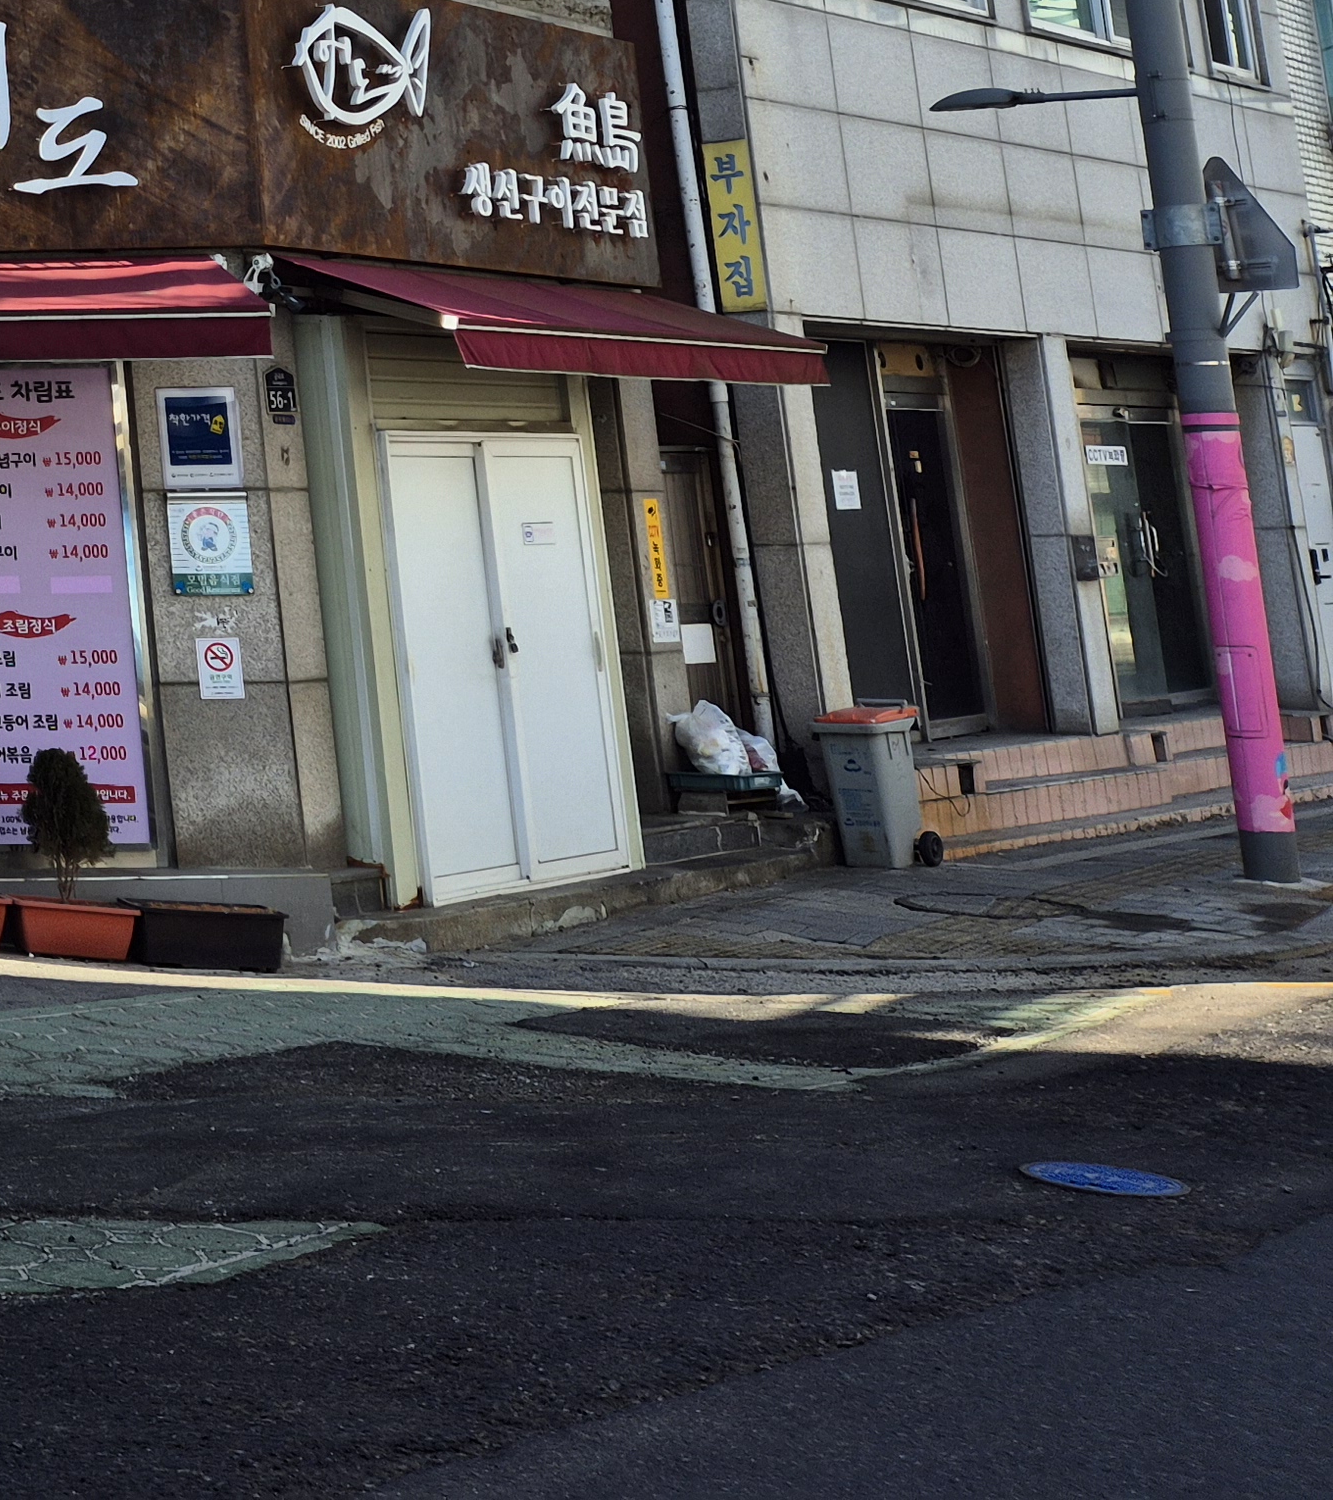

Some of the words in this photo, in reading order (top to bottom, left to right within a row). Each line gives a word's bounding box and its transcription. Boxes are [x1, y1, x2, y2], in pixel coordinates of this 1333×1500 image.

[299, 113, 326, 146] SINCE
[325, 131, 347, 149] 2002
[346, 124, 371, 150] Grilled
[368, 117, 386, 139] Fish
[461, 162, 649, 238] 생선구이전문점
[710, 153, 754, 299] 부자집
[10, 380, 76, 403] 차림표
[269, 391, 296, 411] 56-1
[3, 619, 57, 634] 조림정식
[5, 682, 31, 700] 조림
[33, 714, 59, 731] 조림
